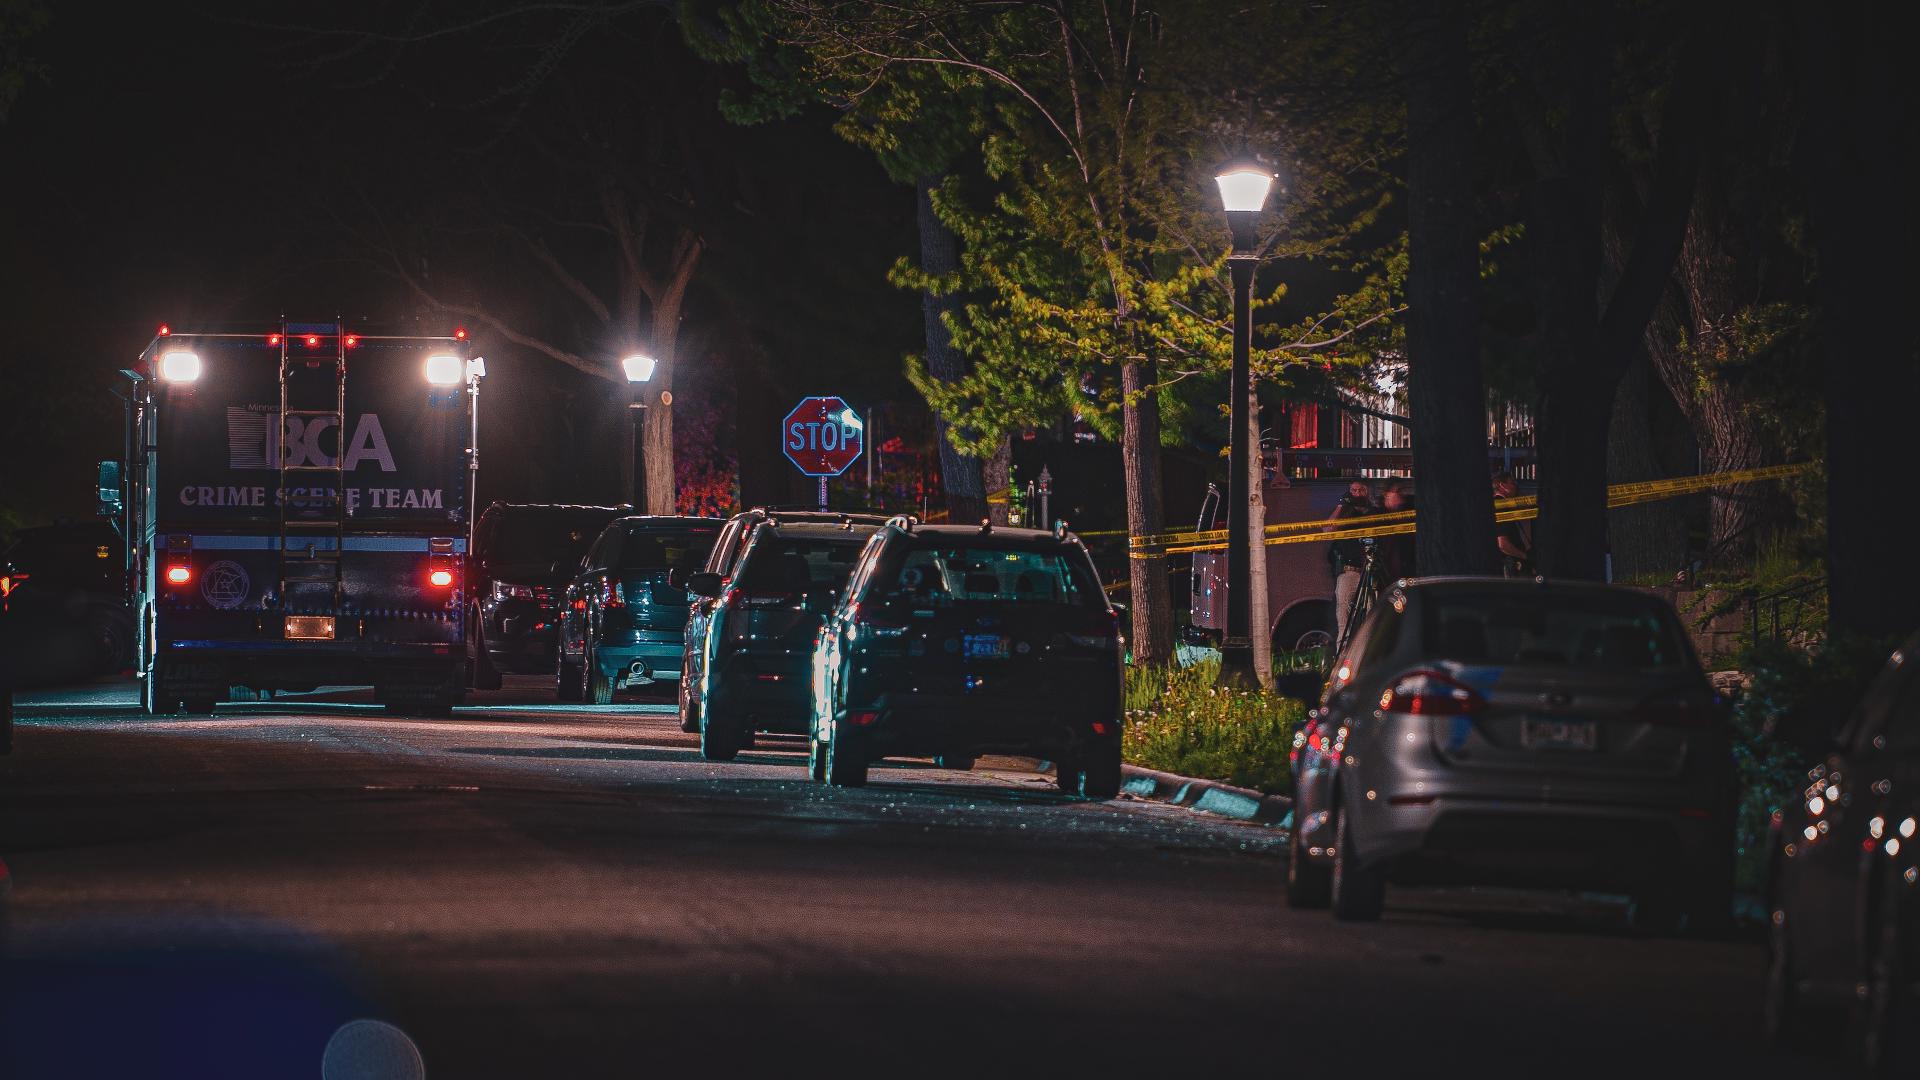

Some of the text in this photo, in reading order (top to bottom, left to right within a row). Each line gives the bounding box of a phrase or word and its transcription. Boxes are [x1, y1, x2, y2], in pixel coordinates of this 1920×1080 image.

[266, 413, 397, 472] BCA
[789, 422, 856, 451] STOP
[179, 486, 265, 507] CRIME
[368, 488, 444, 509] TEAM
